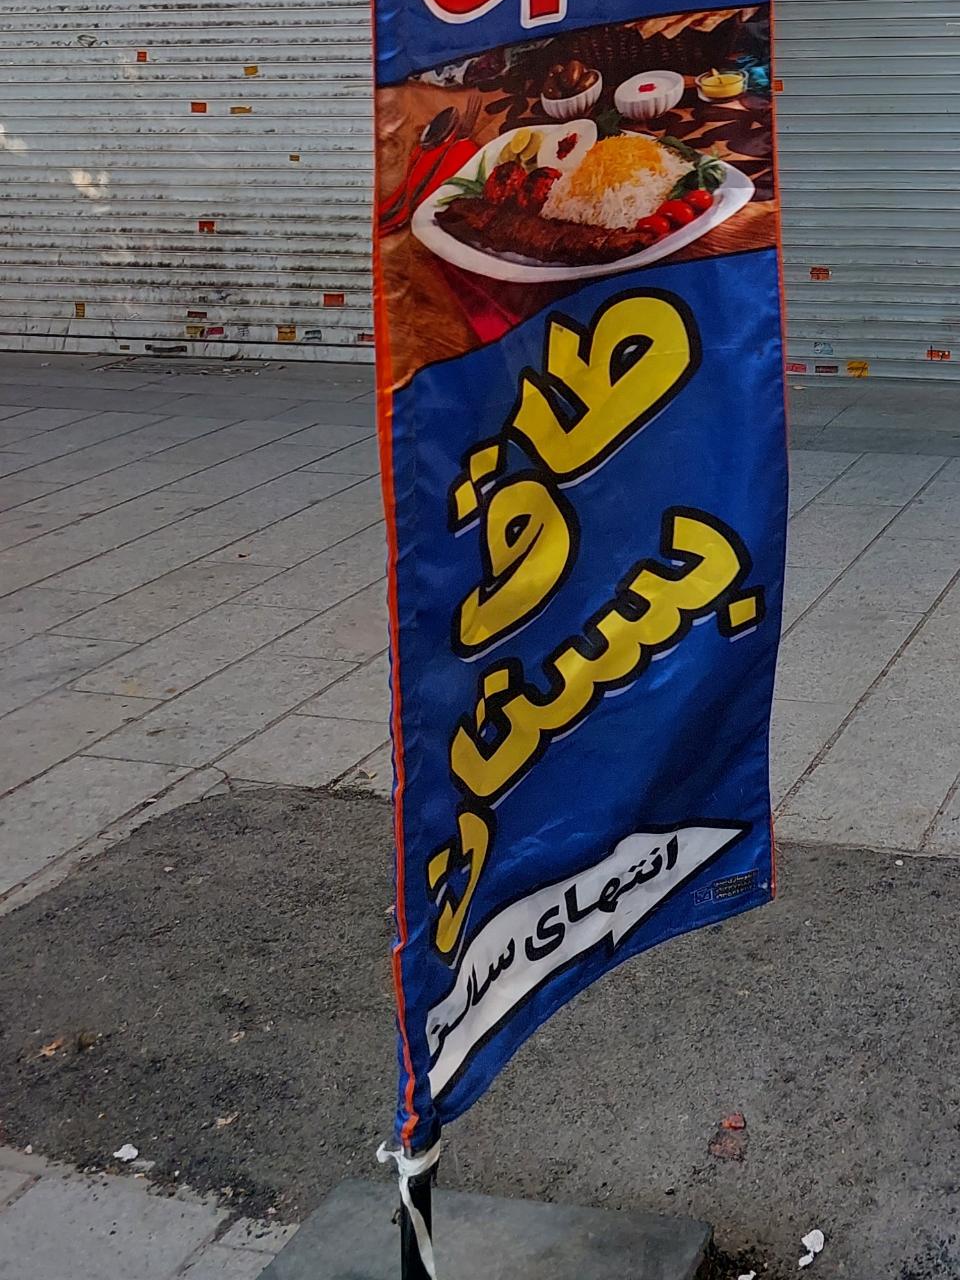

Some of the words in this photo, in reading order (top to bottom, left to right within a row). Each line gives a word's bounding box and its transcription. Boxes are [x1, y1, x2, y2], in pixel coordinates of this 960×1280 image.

[448, 287, 701, 663] طاق
[425, 505, 766, 970] بستان
[524, 833, 681, 962] انتهای
